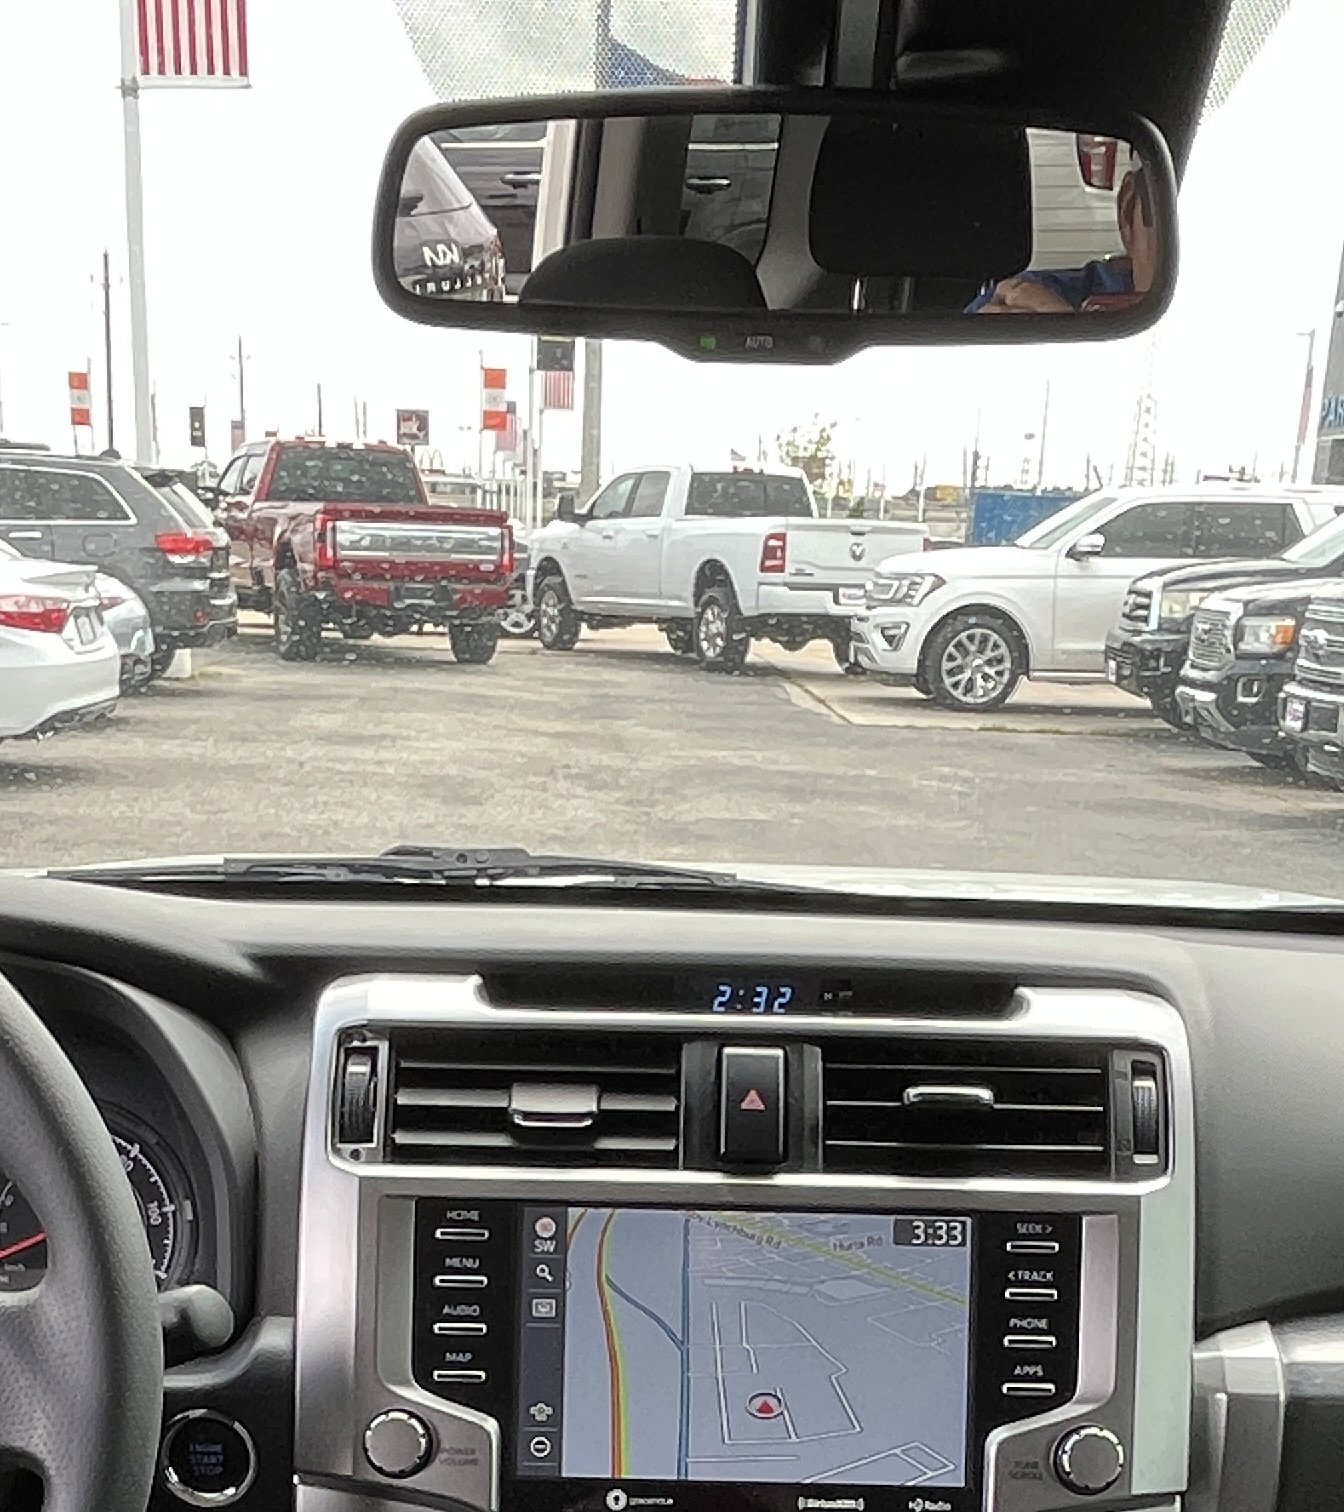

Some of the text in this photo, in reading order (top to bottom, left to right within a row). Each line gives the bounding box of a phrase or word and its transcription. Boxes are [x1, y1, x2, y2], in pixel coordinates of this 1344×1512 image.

[745, 335, 774, 350] AUTO
[712, 984, 792, 1013] 2:32
[146, 1201, 162, 1225] 100
[446, 1211, 480, 1221] HOME
[911, 1221, 963, 1246] 3:33
[534, 1239, 556, 1252] SW
[766, 1234, 782, 1249] Rd
[866, 1233, 883, 1248] Rd
[444, 1257, 479, 1268] MENU
[1018, 1270, 1054, 1281] TRACK
[443, 1305, 480, 1316] AUDIO
[1009, 1318, 1048, 1329] PHONE
[445, 1352, 472, 1362] MAP
[1013, 1364, 1044, 1376] APPS
